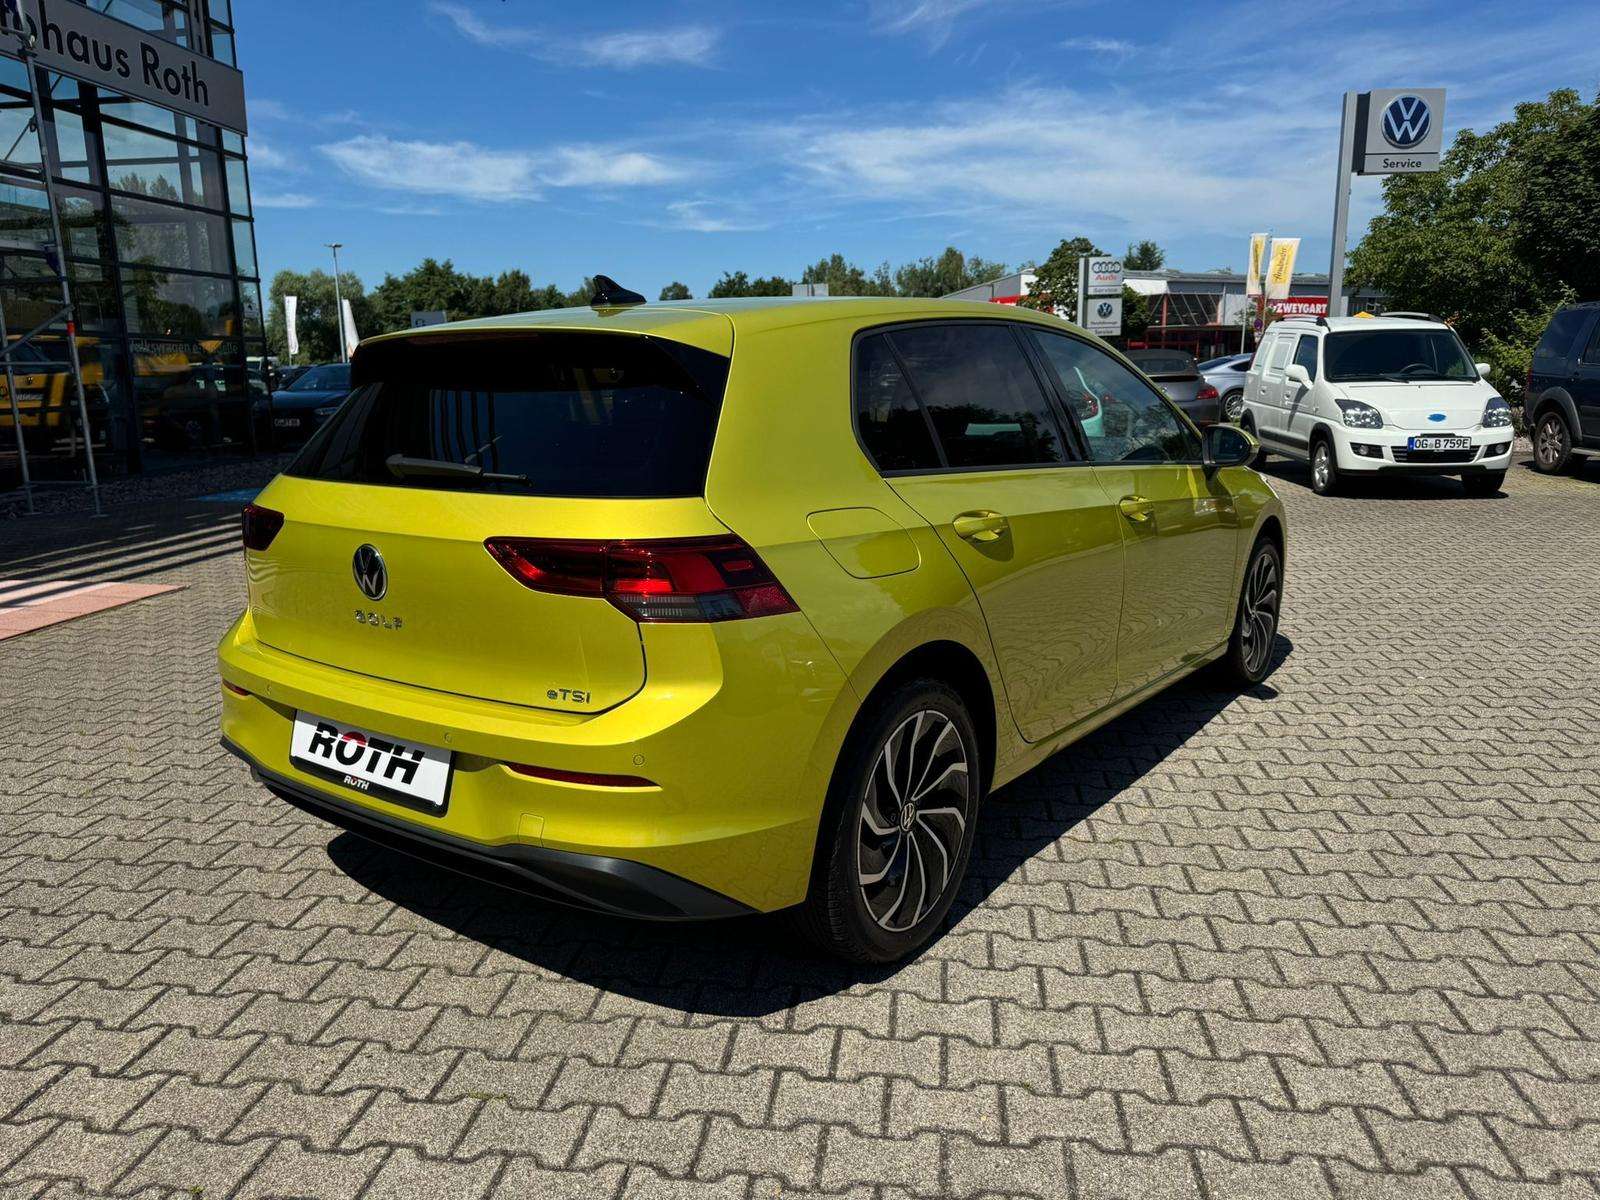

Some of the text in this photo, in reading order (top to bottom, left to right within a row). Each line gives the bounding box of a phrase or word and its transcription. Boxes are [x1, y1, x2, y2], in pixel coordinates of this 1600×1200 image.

[140, 42, 209, 106] Roth
[1382, 158, 1422, 169] Service
[1276, 302, 1328, 315] ZWEYGART
[1415, 439, 1469, 449] OG B 759E
[354, 609, 403, 630] GOLF
[546, 688, 590, 704] eTSI
[308, 721, 425, 786] ROTH
[343, 775, 370, 791] ROTH
